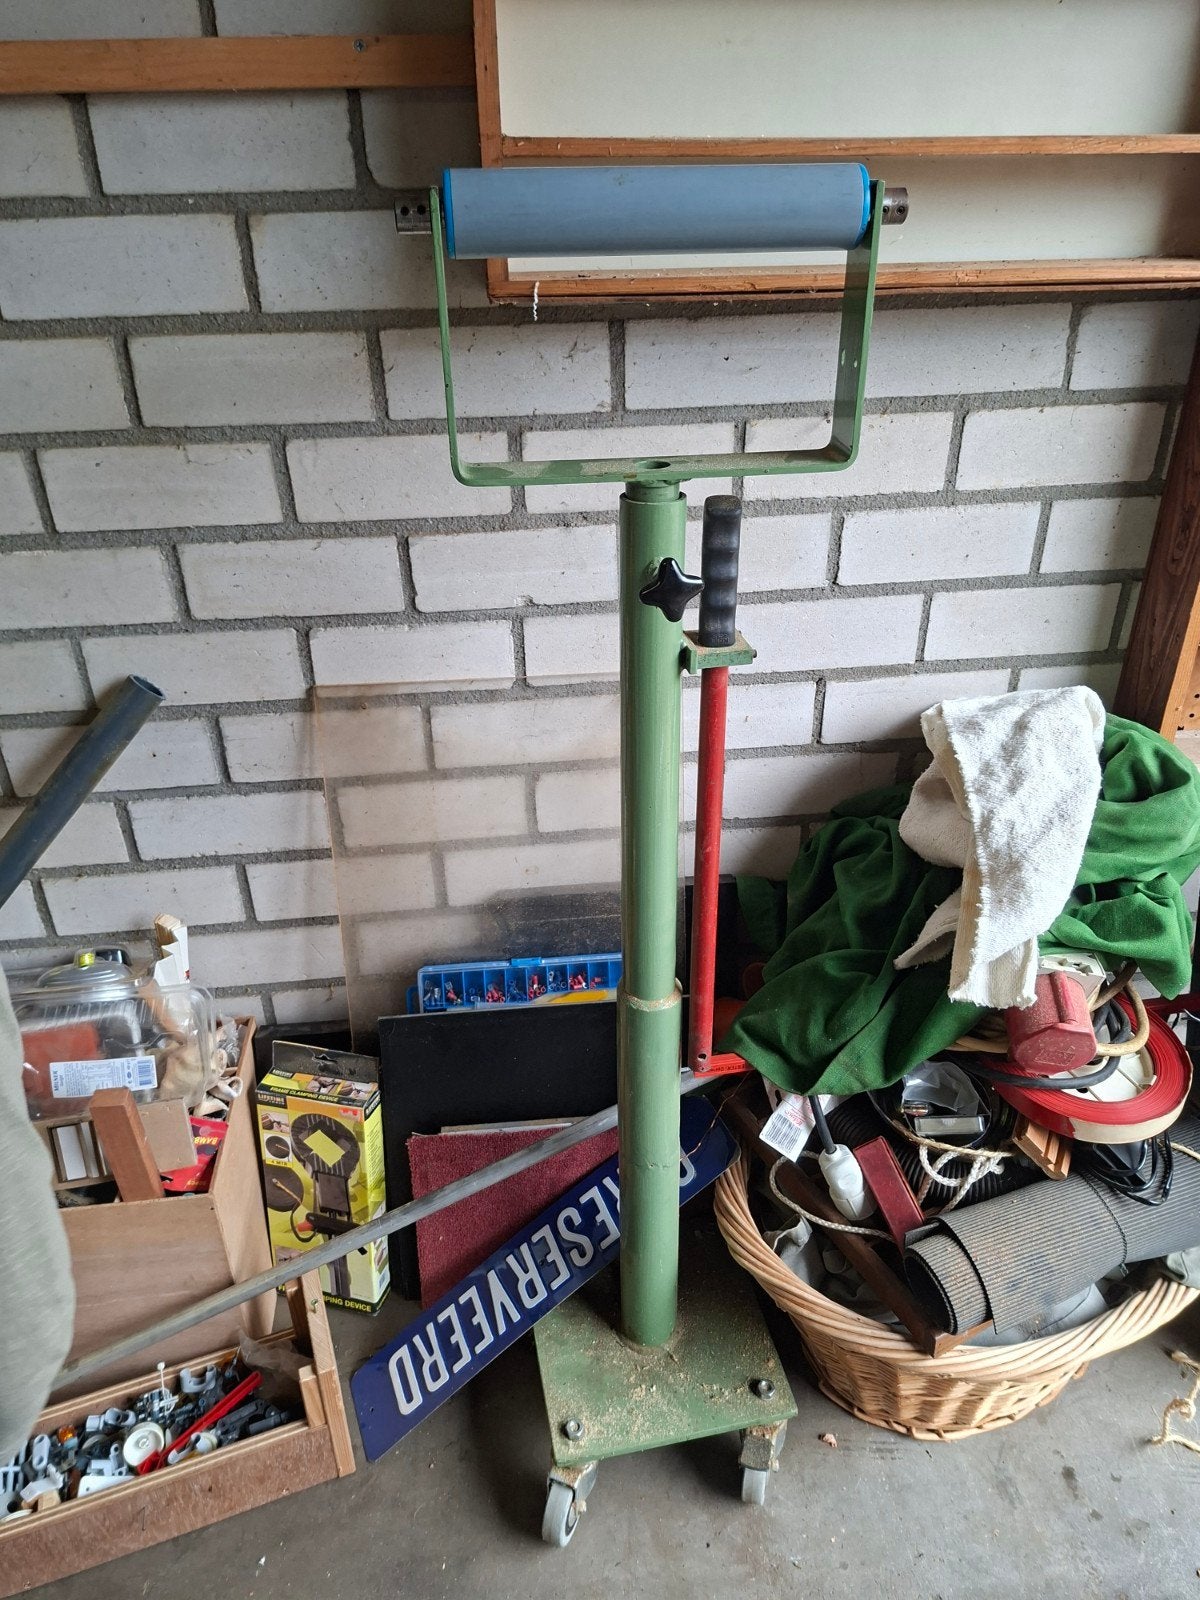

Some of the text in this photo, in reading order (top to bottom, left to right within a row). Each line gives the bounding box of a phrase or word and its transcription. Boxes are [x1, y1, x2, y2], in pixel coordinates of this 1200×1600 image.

[289, 1090, 318, 1099] CLAMPING
[388, 1143, 696, 1416] ESERVEERD
[344, 1300, 371, 1312] DEVICE
